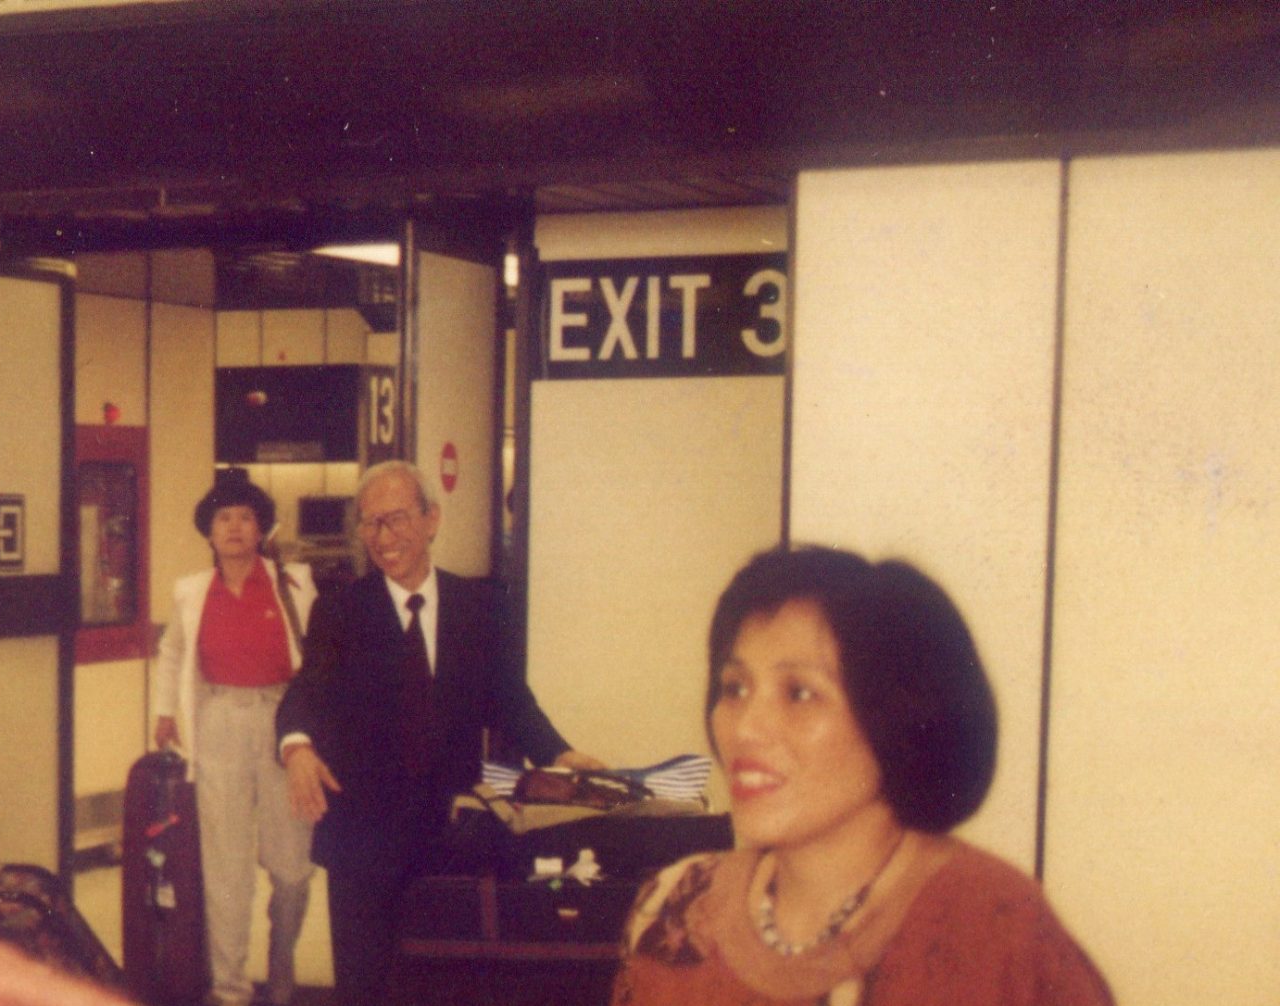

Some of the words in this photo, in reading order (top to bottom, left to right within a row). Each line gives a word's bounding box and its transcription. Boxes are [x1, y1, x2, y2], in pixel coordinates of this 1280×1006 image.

[549, 273, 712, 363] EXIT
[740, 268, 788, 358] 3
[370, 375, 396, 446] 13
